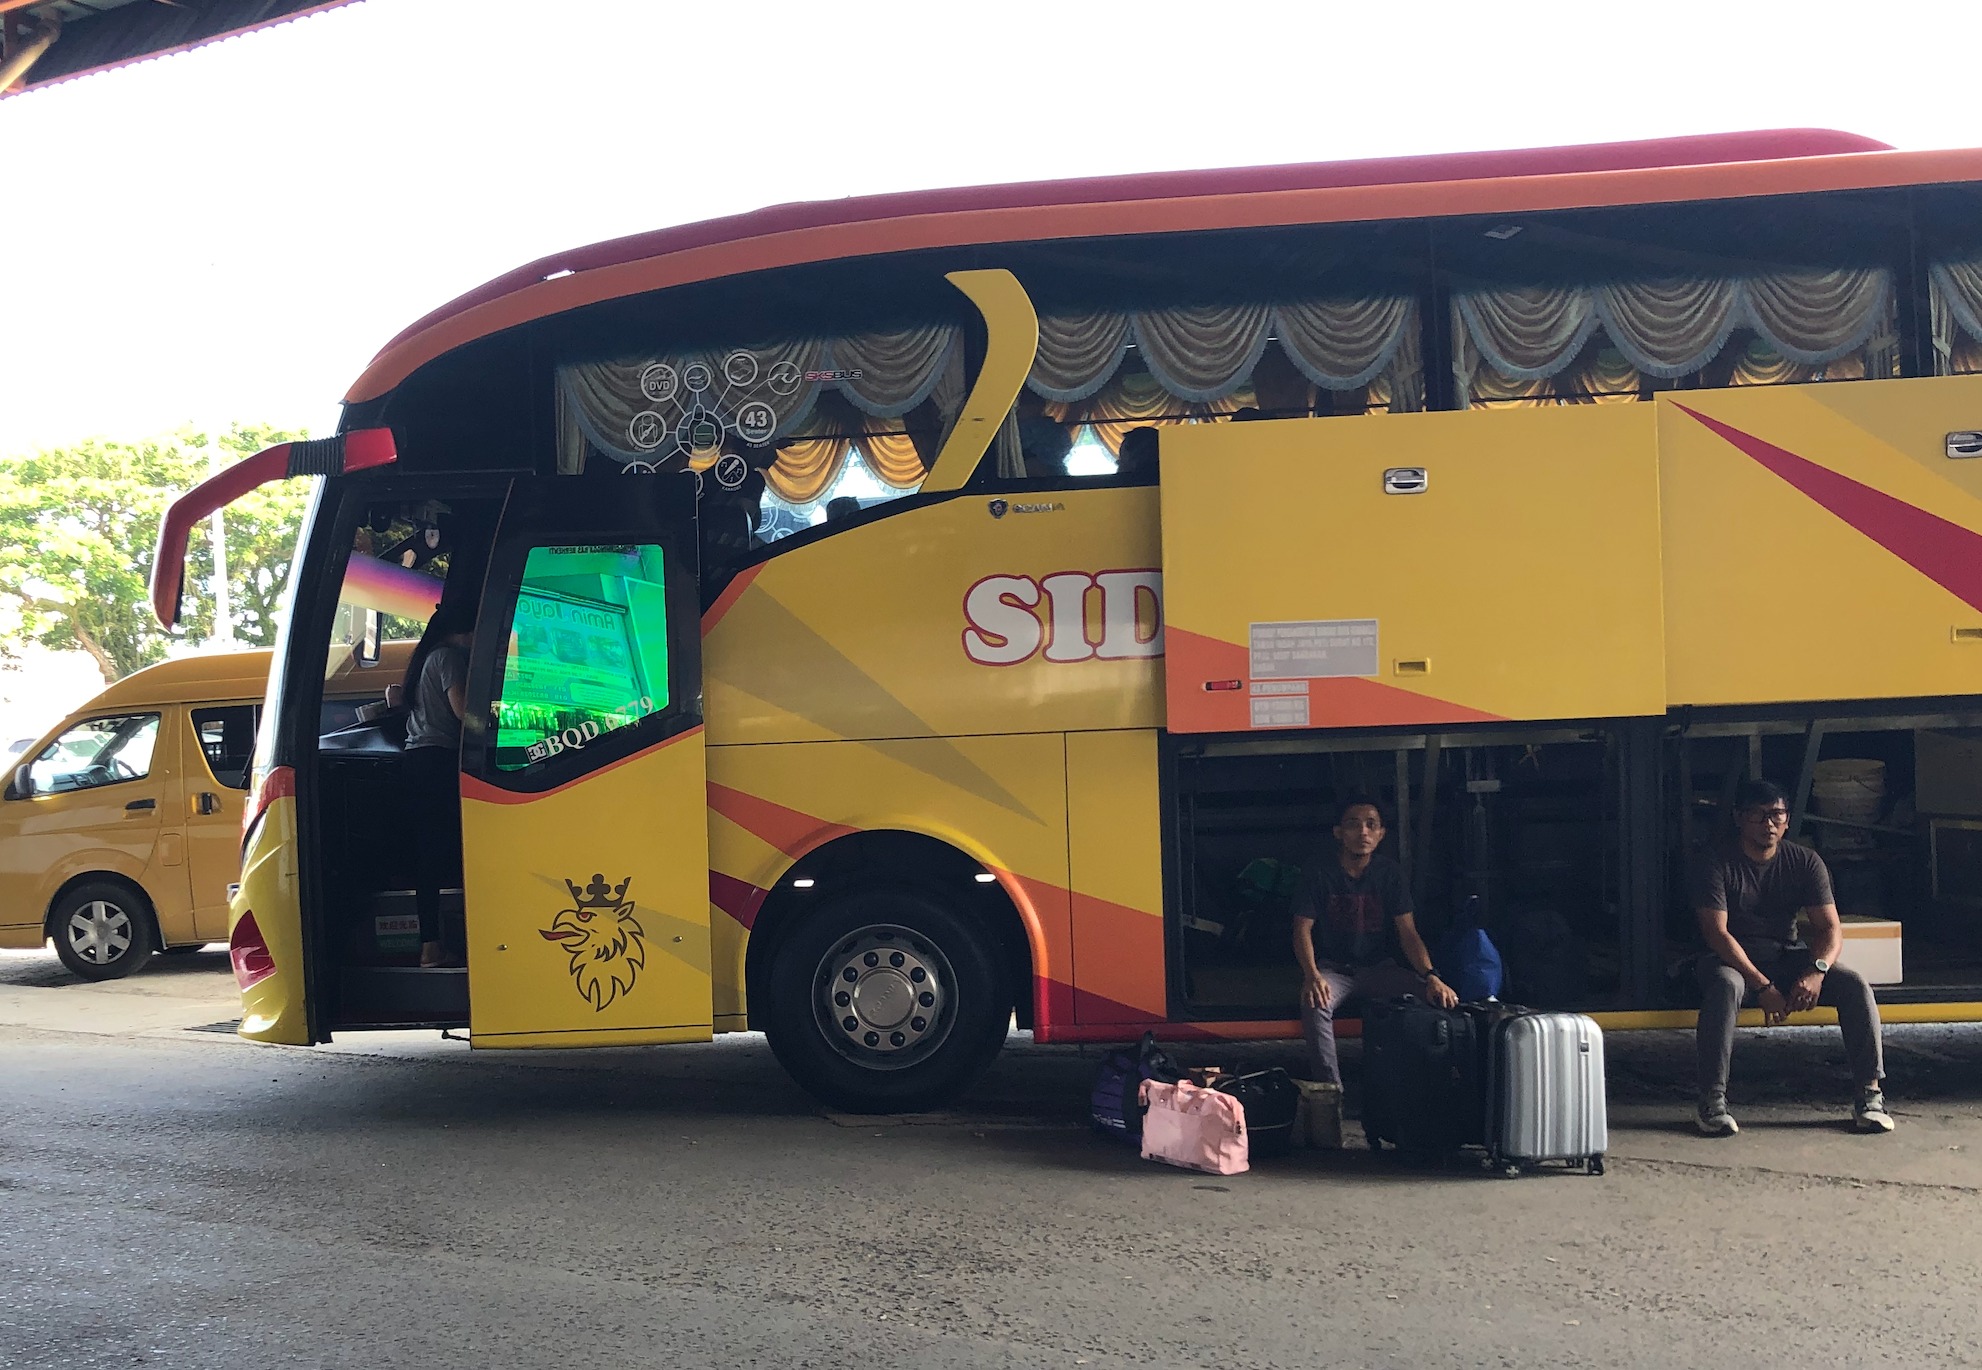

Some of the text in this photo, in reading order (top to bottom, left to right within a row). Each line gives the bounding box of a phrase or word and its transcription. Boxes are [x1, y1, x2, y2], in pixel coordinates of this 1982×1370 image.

[649, 381, 670, 391] DVD
[745, 410, 768, 428] 43
[544, 720, 600, 758] BQD
